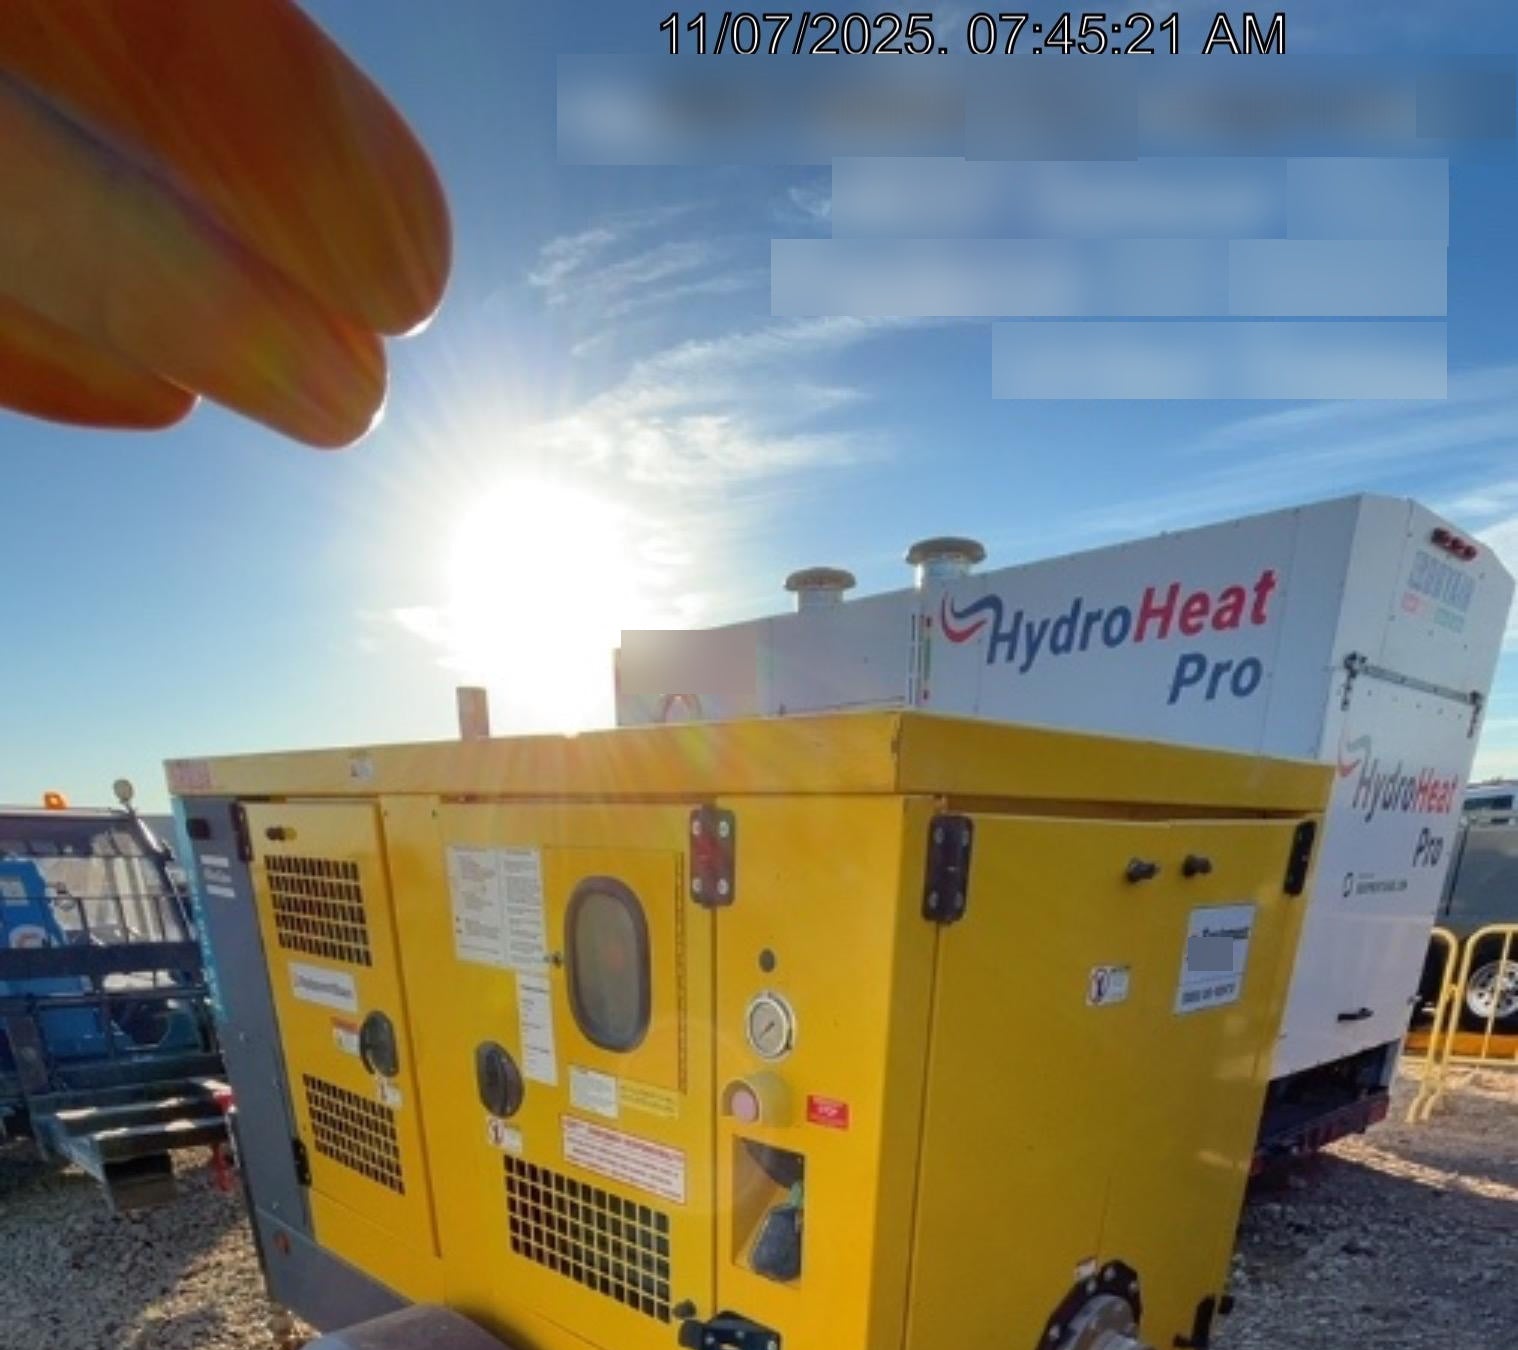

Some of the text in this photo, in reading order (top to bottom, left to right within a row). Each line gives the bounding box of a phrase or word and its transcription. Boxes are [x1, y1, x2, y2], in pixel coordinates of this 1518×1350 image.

[985, 569, 1276, 675] HydroHeat
[1167, 652, 1263, 706] Pro
[1352, 758, 1459, 824] HydroHeat
[1412, 827, 1445, 868] Pro
